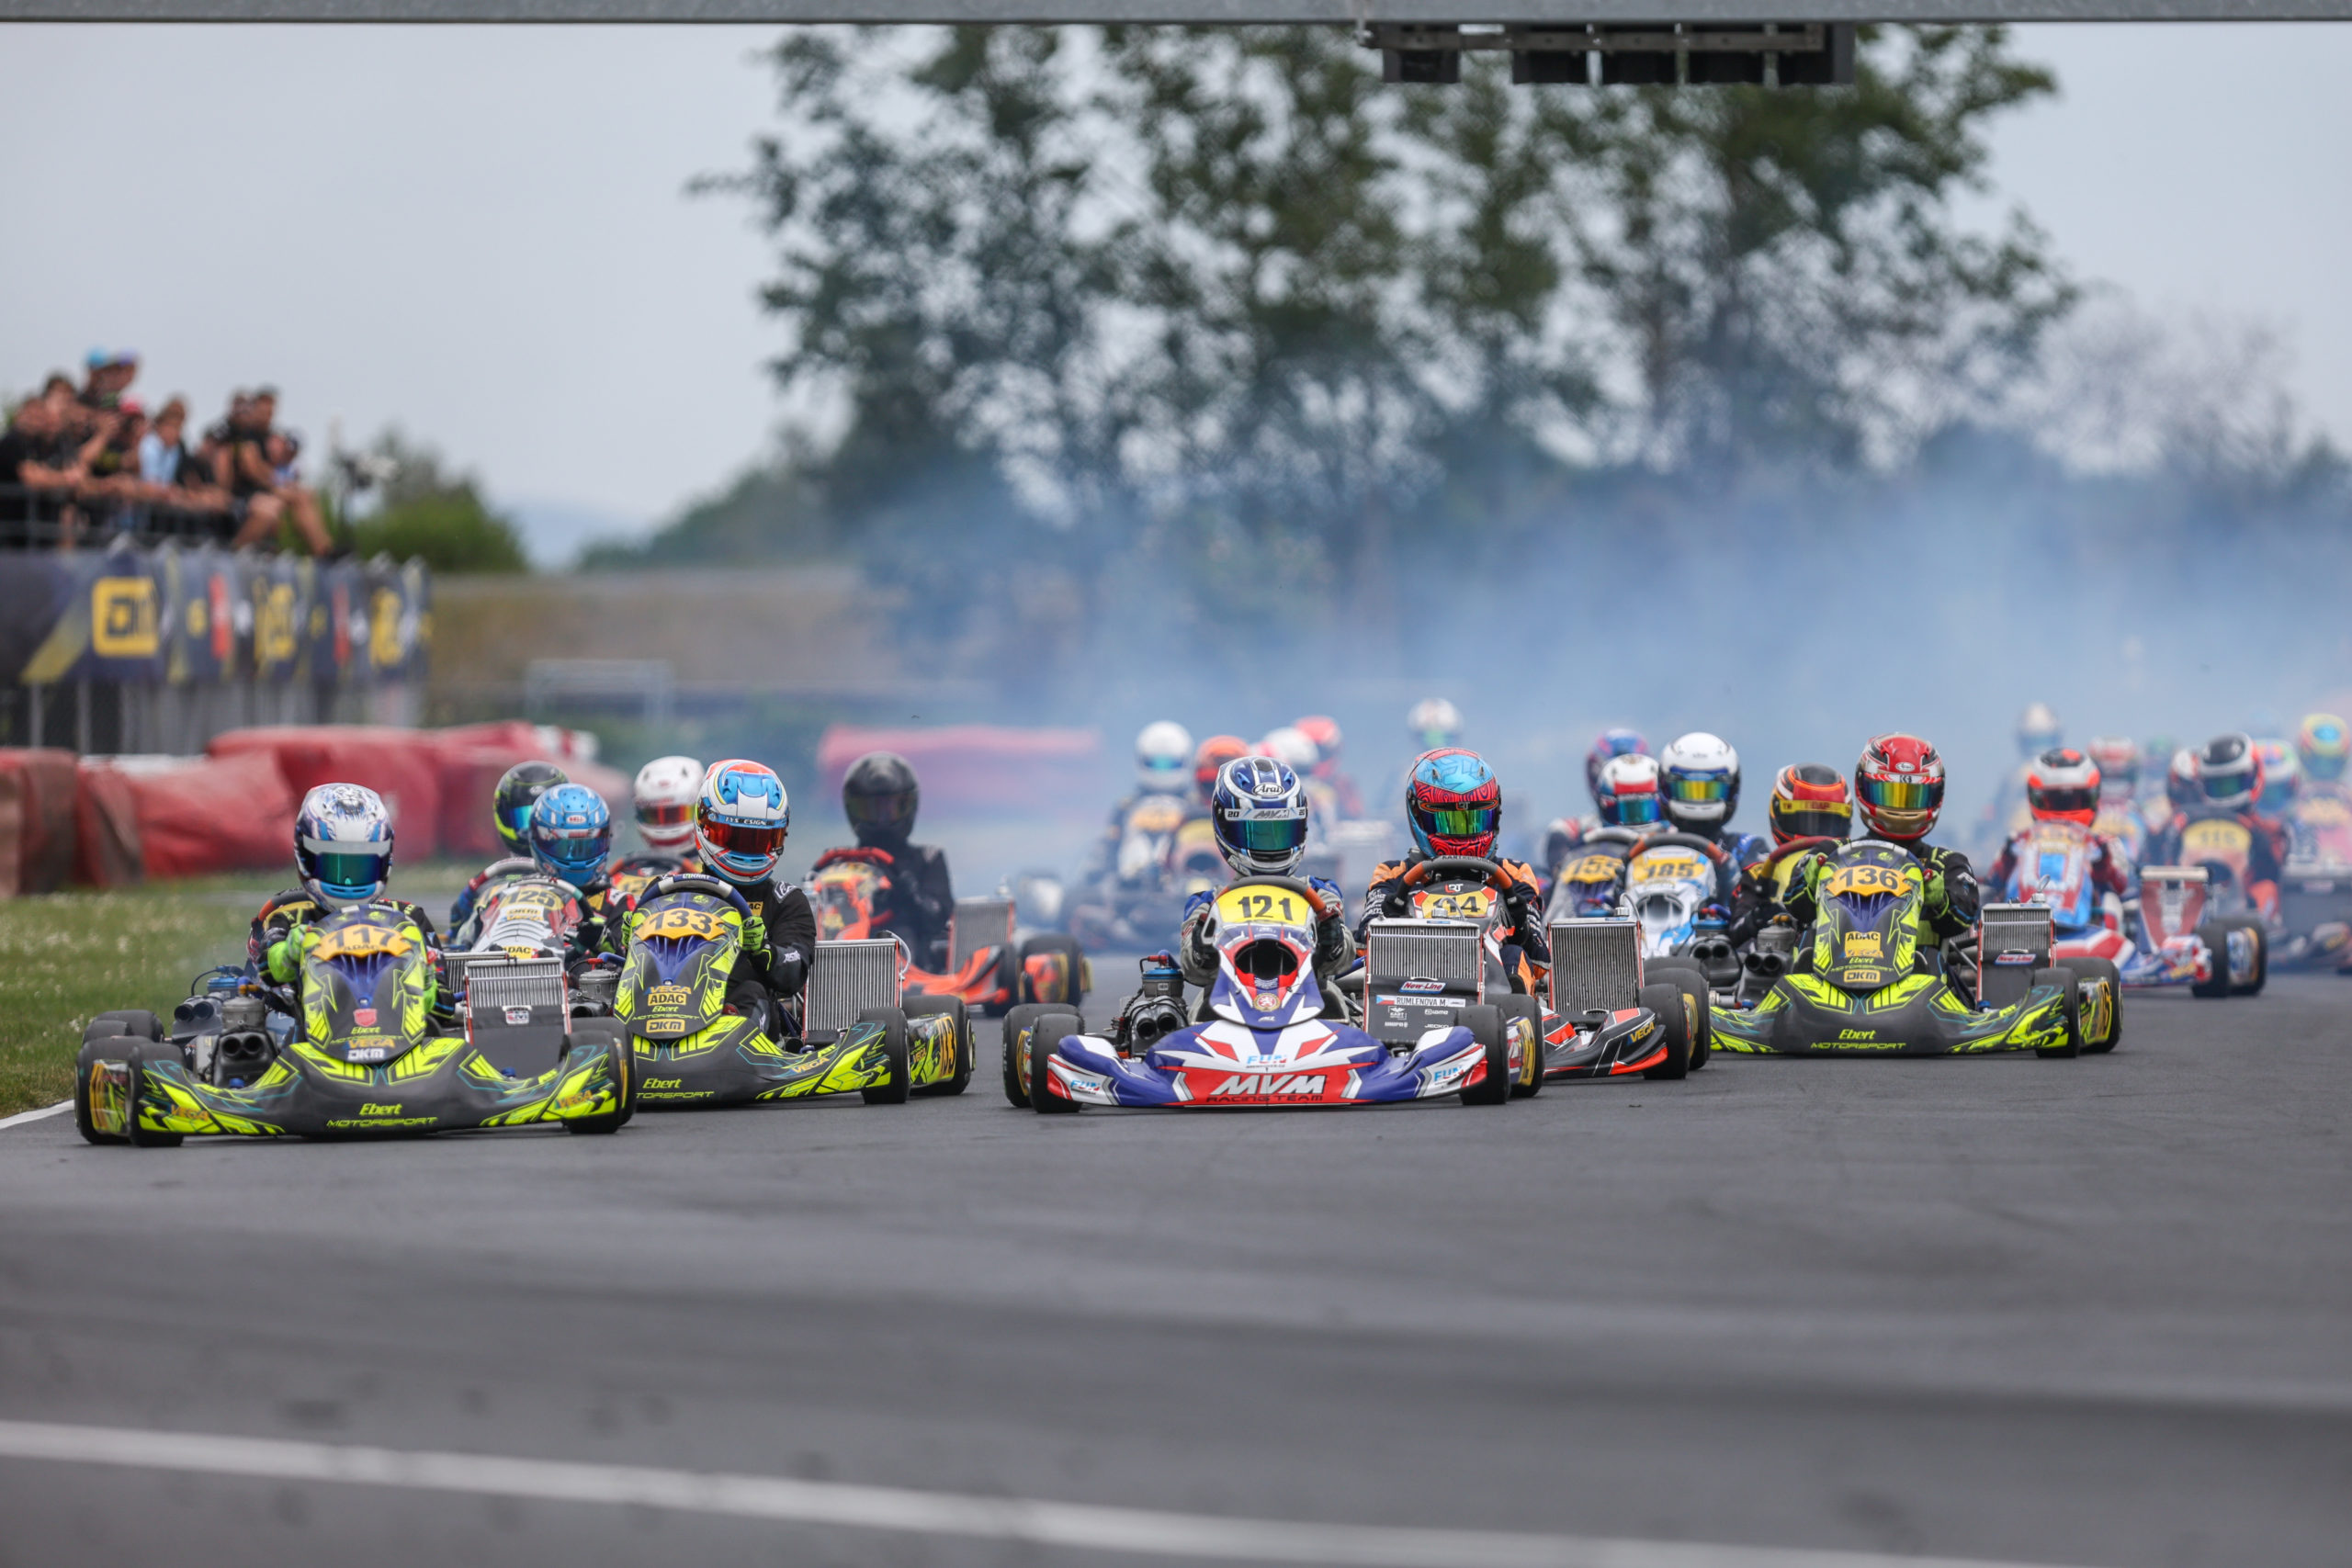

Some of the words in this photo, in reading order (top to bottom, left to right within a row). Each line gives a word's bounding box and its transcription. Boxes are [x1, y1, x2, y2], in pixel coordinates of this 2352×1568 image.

[1256, 784, 1281, 793] Arai
[1839, 867, 1898, 889] 136
[508, 889, 555, 908] 125
[1238, 895, 1294, 921] 121
[649, 910, 713, 934] 133
[328, 926, 395, 949] 117
[1847, 933, 1879, 942] ADAC
[503, 946, 531, 954] DAC
[1846, 971, 1878, 980] DKM
[648, 985, 692, 994] VEGA
[1404, 982, 1443, 990] New-Line
[650, 994, 685, 1004] ADAC
[1396, 997, 1438, 1006] RUMLENOVA
[350, 1027, 381, 1035] Ebert
[649, 1021, 682, 1031] DKM
[1629, 1021, 1655, 1043] VEGA
[1838, 1029, 1876, 1040] Ebert
[347, 1039, 395, 1049] VEGA
[347, 1048, 385, 1060] DKM
[791, 1057, 831, 1074] VEGA
[642, 1077, 682, 1089] Ebert
[1209, 1074, 1327, 1095] MVM
[636, 1090, 715, 1099] TORSPORT
[359, 1102, 402, 1115] Ebert
[326, 1117, 438, 1128] MOTORSPORT
